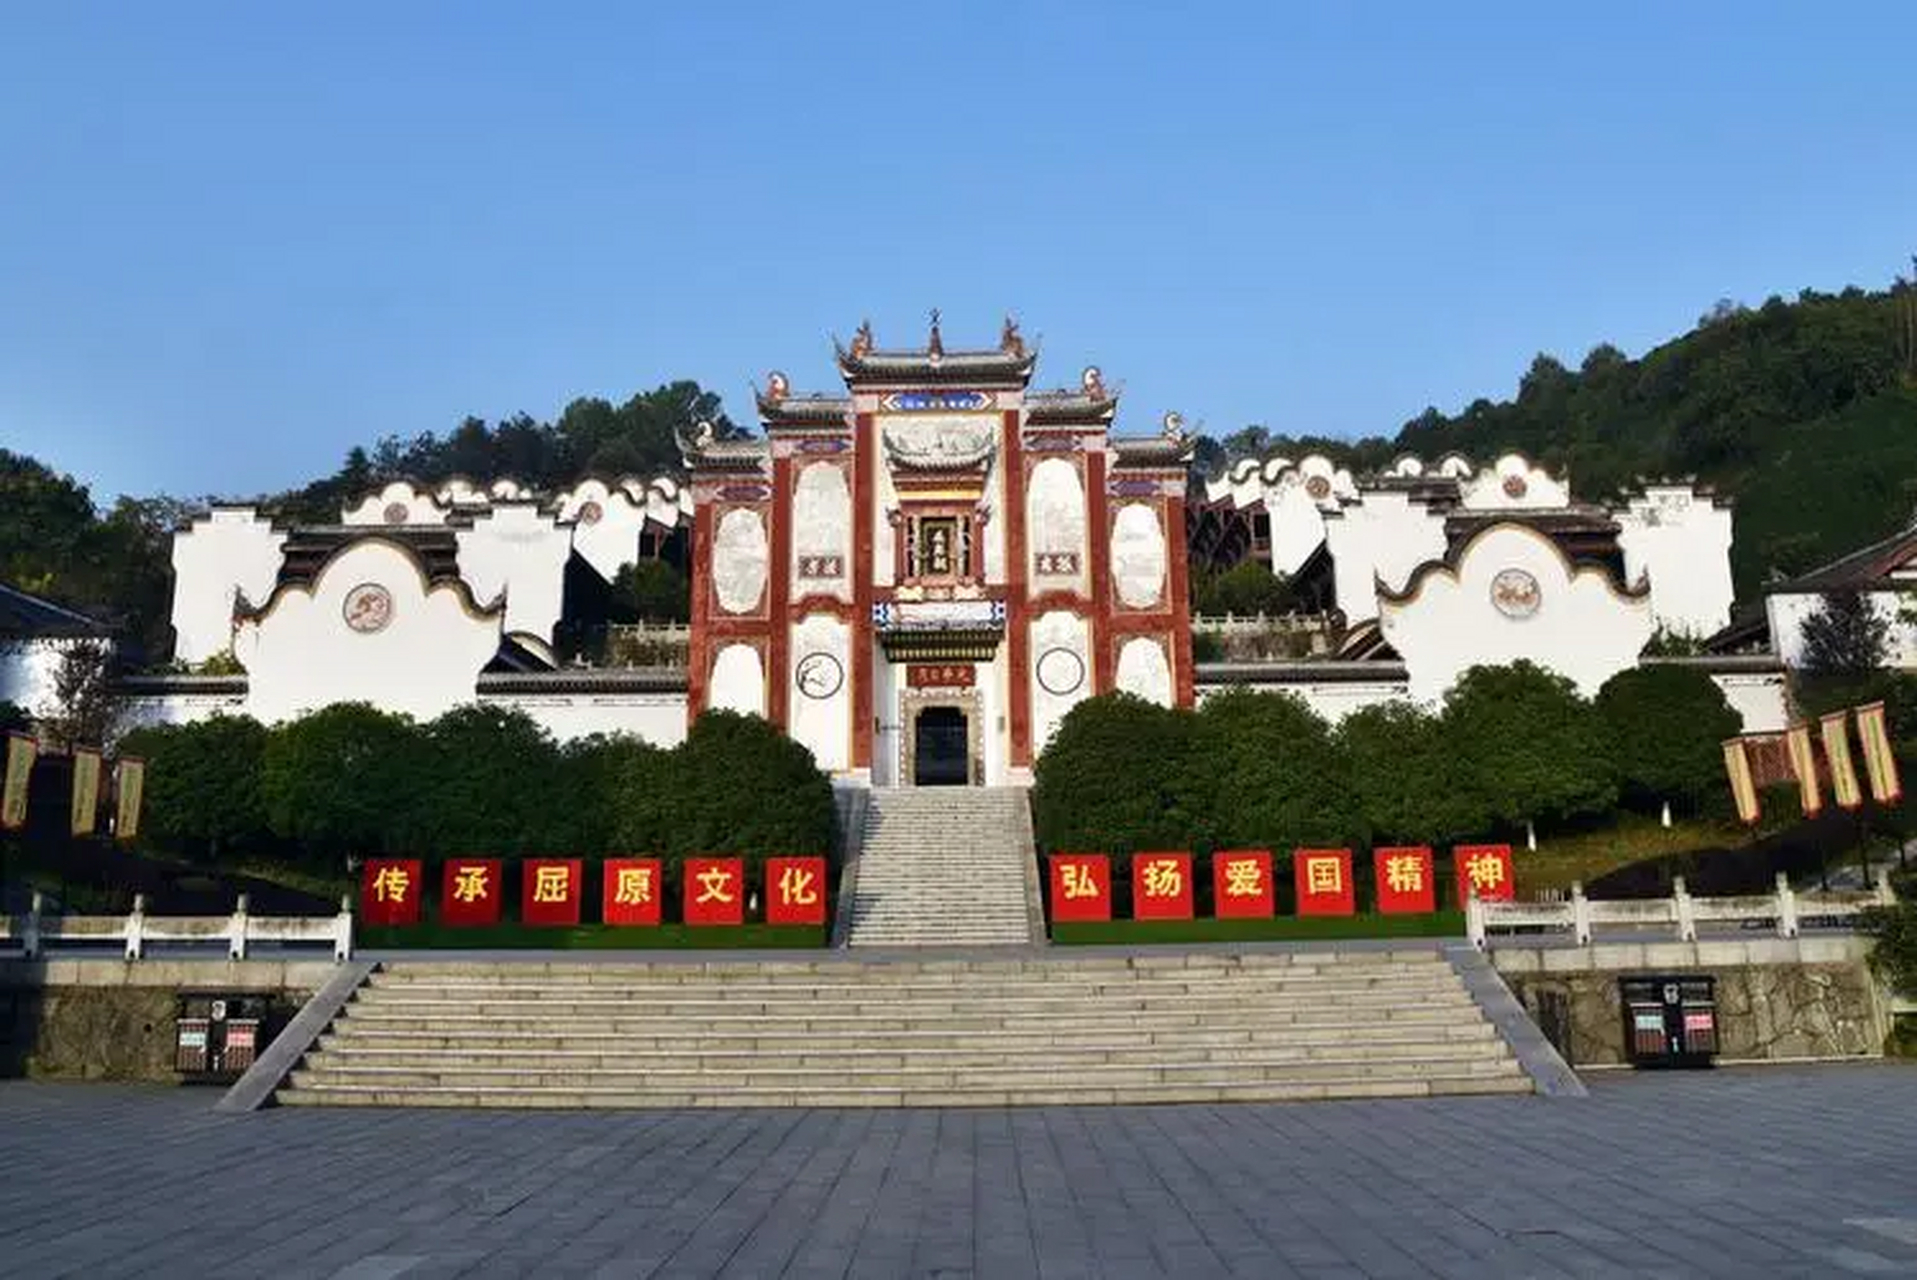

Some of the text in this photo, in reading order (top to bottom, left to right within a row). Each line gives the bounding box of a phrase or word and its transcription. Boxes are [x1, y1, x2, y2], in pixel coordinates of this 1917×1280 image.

[372, 866, 817, 905] 传承屈原文化
[1060, 853, 1504, 898] 弘扬爱国精神
